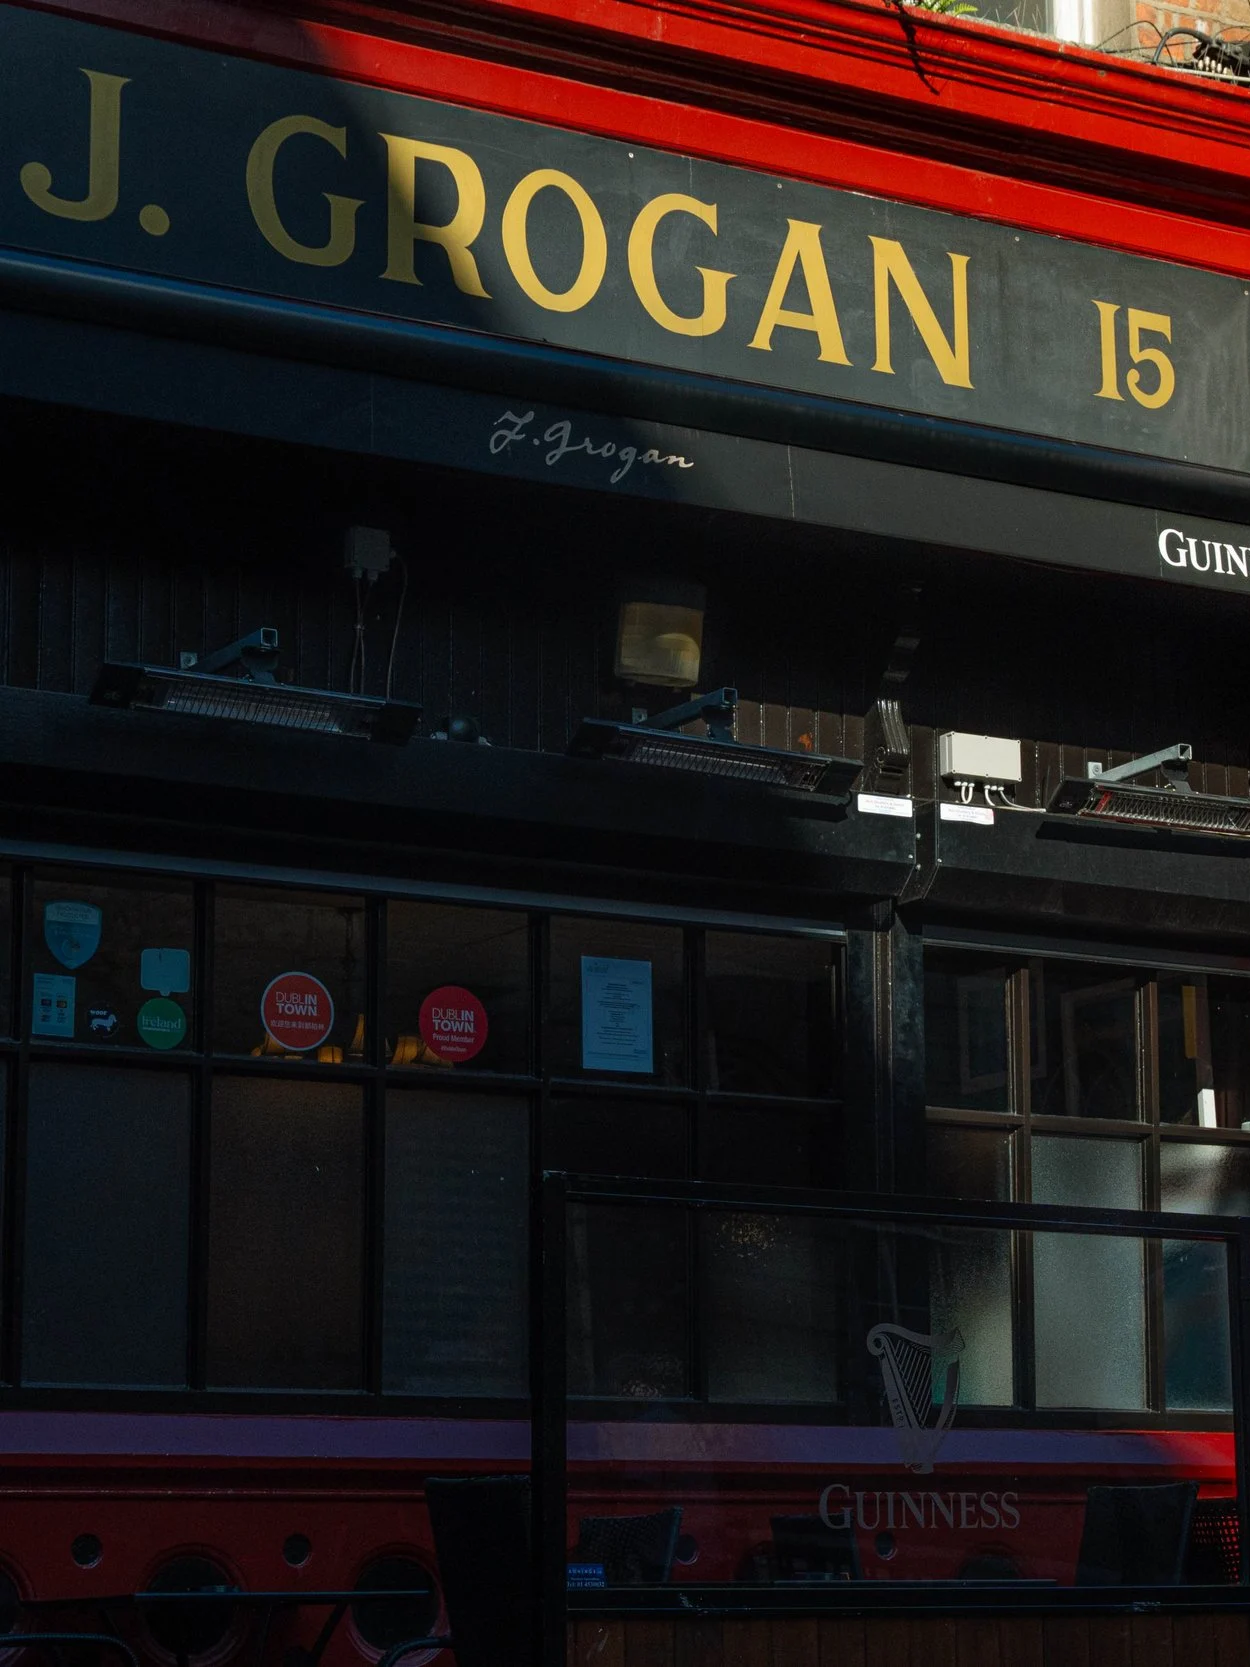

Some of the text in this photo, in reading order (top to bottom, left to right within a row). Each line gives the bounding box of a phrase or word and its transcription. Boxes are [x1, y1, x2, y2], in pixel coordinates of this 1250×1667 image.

[20, 67, 1176, 410] J. GROGAN 15
[275, 991, 318, 1006] DUBLIN
[275, 1003, 318, 1017] TOWN
[432, 1007, 475, 1022] DUBLIN
[432, 1020, 475, 1033] TOWN
[819, 1483, 1022, 1531] GUINNESS
